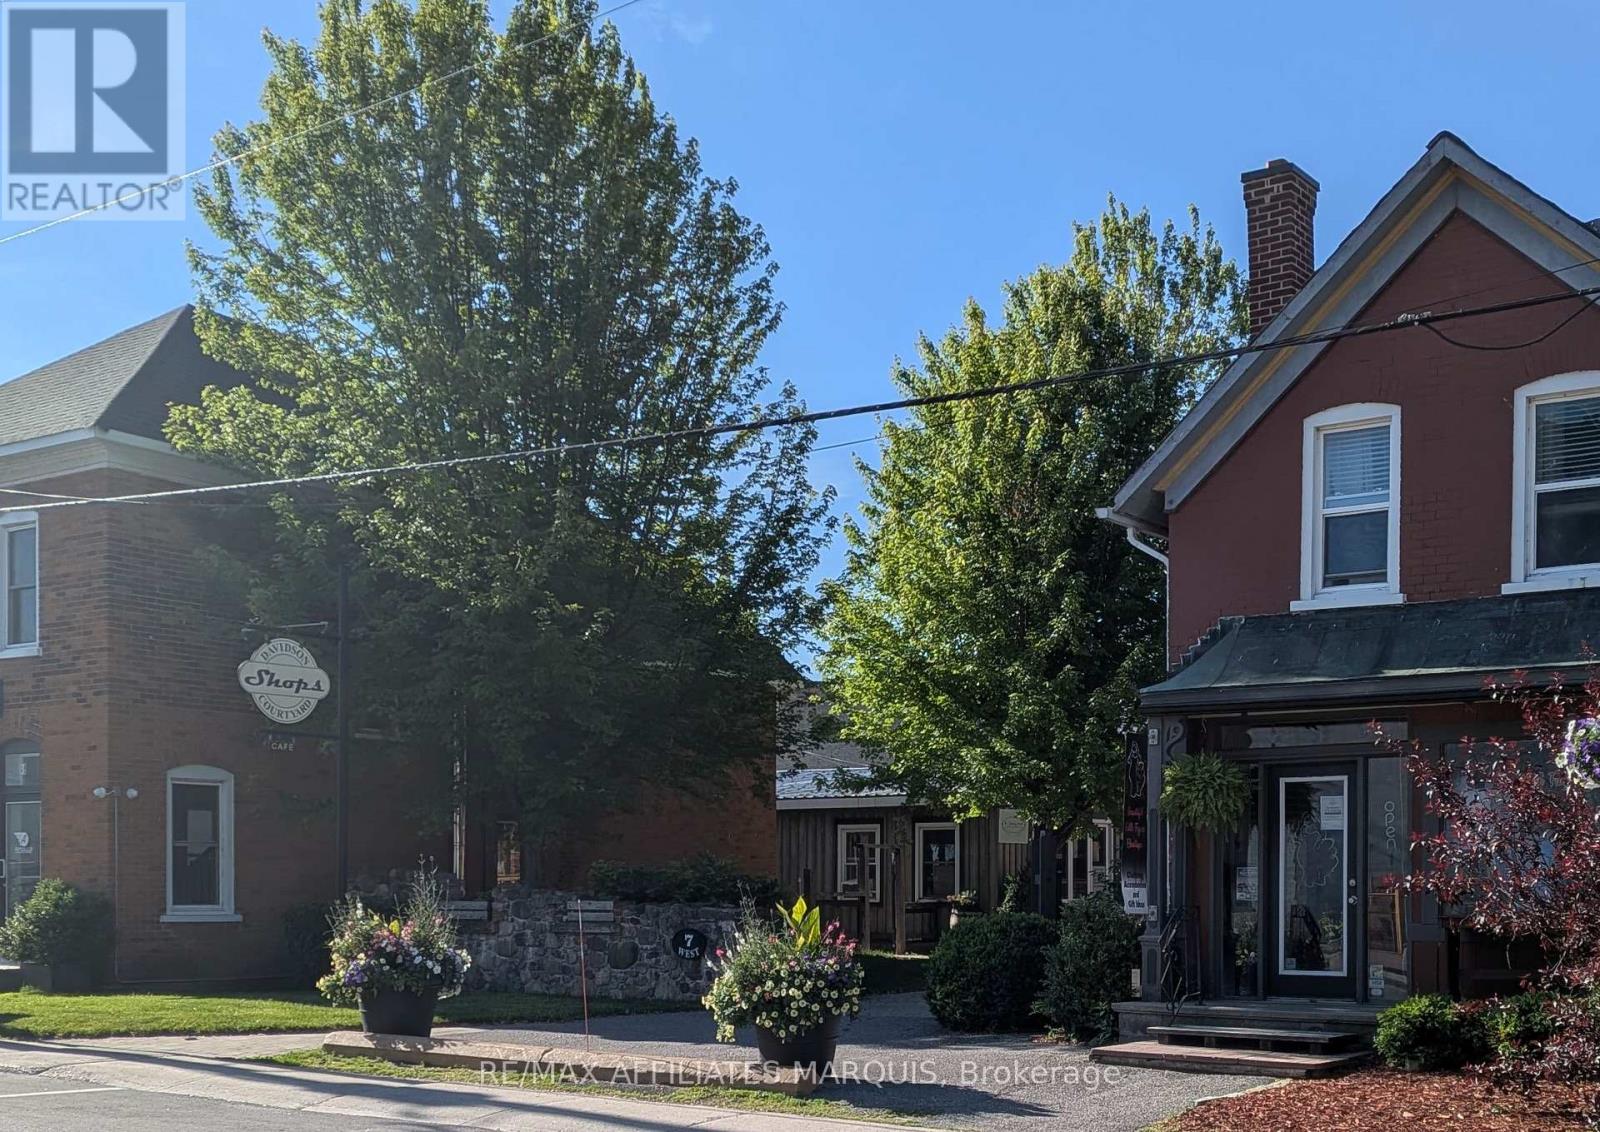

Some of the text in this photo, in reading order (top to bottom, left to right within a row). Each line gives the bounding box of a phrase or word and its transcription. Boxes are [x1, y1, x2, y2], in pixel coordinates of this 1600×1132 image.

[260, 642, 311, 666] DAVIDSON
[244, 669, 325, 694] Shops
[258, 694, 312, 719] COURTYARD
[271, 742, 294, 752] CAFE
[684, 933, 694, 947] 7
[678, 946, 700, 958] WEST
